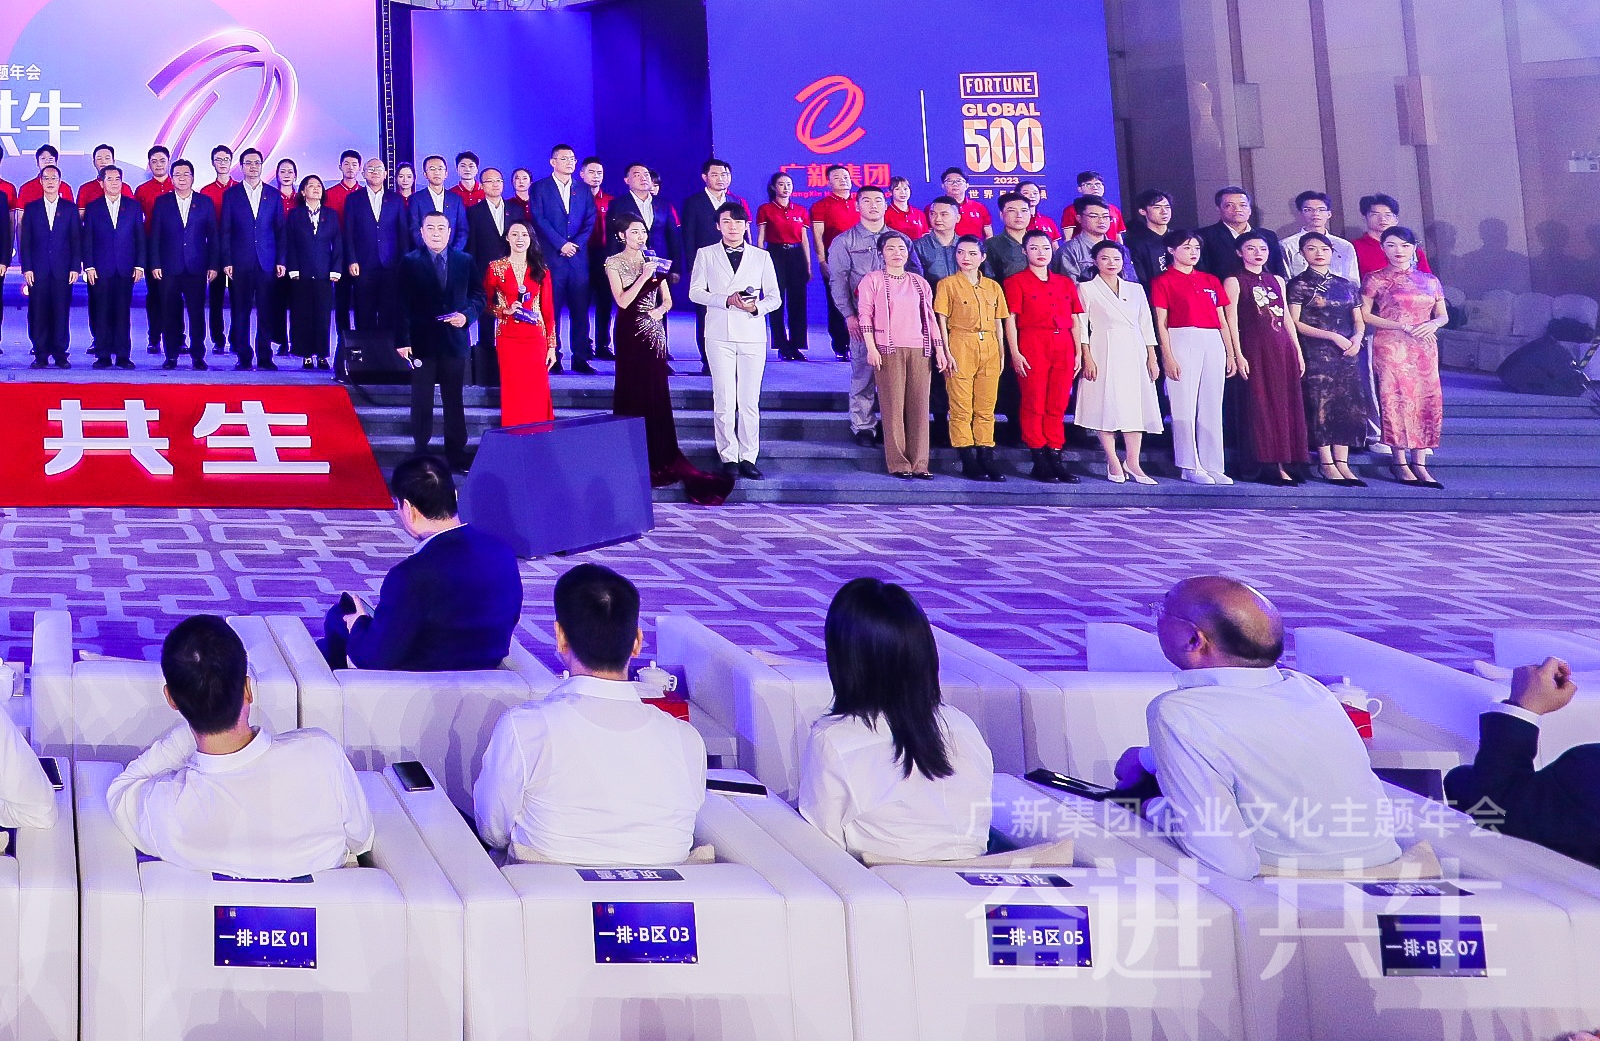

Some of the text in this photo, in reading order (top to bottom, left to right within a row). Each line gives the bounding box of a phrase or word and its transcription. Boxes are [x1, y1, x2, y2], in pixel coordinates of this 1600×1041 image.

[965, 77, 1033, 93] FORTUNE
[961, 102, 1041, 117] GLOBAL
[963, 118, 1045, 172] 500
[993, 177, 1020, 185] 2023
[44, 398, 331, 476] 共生
